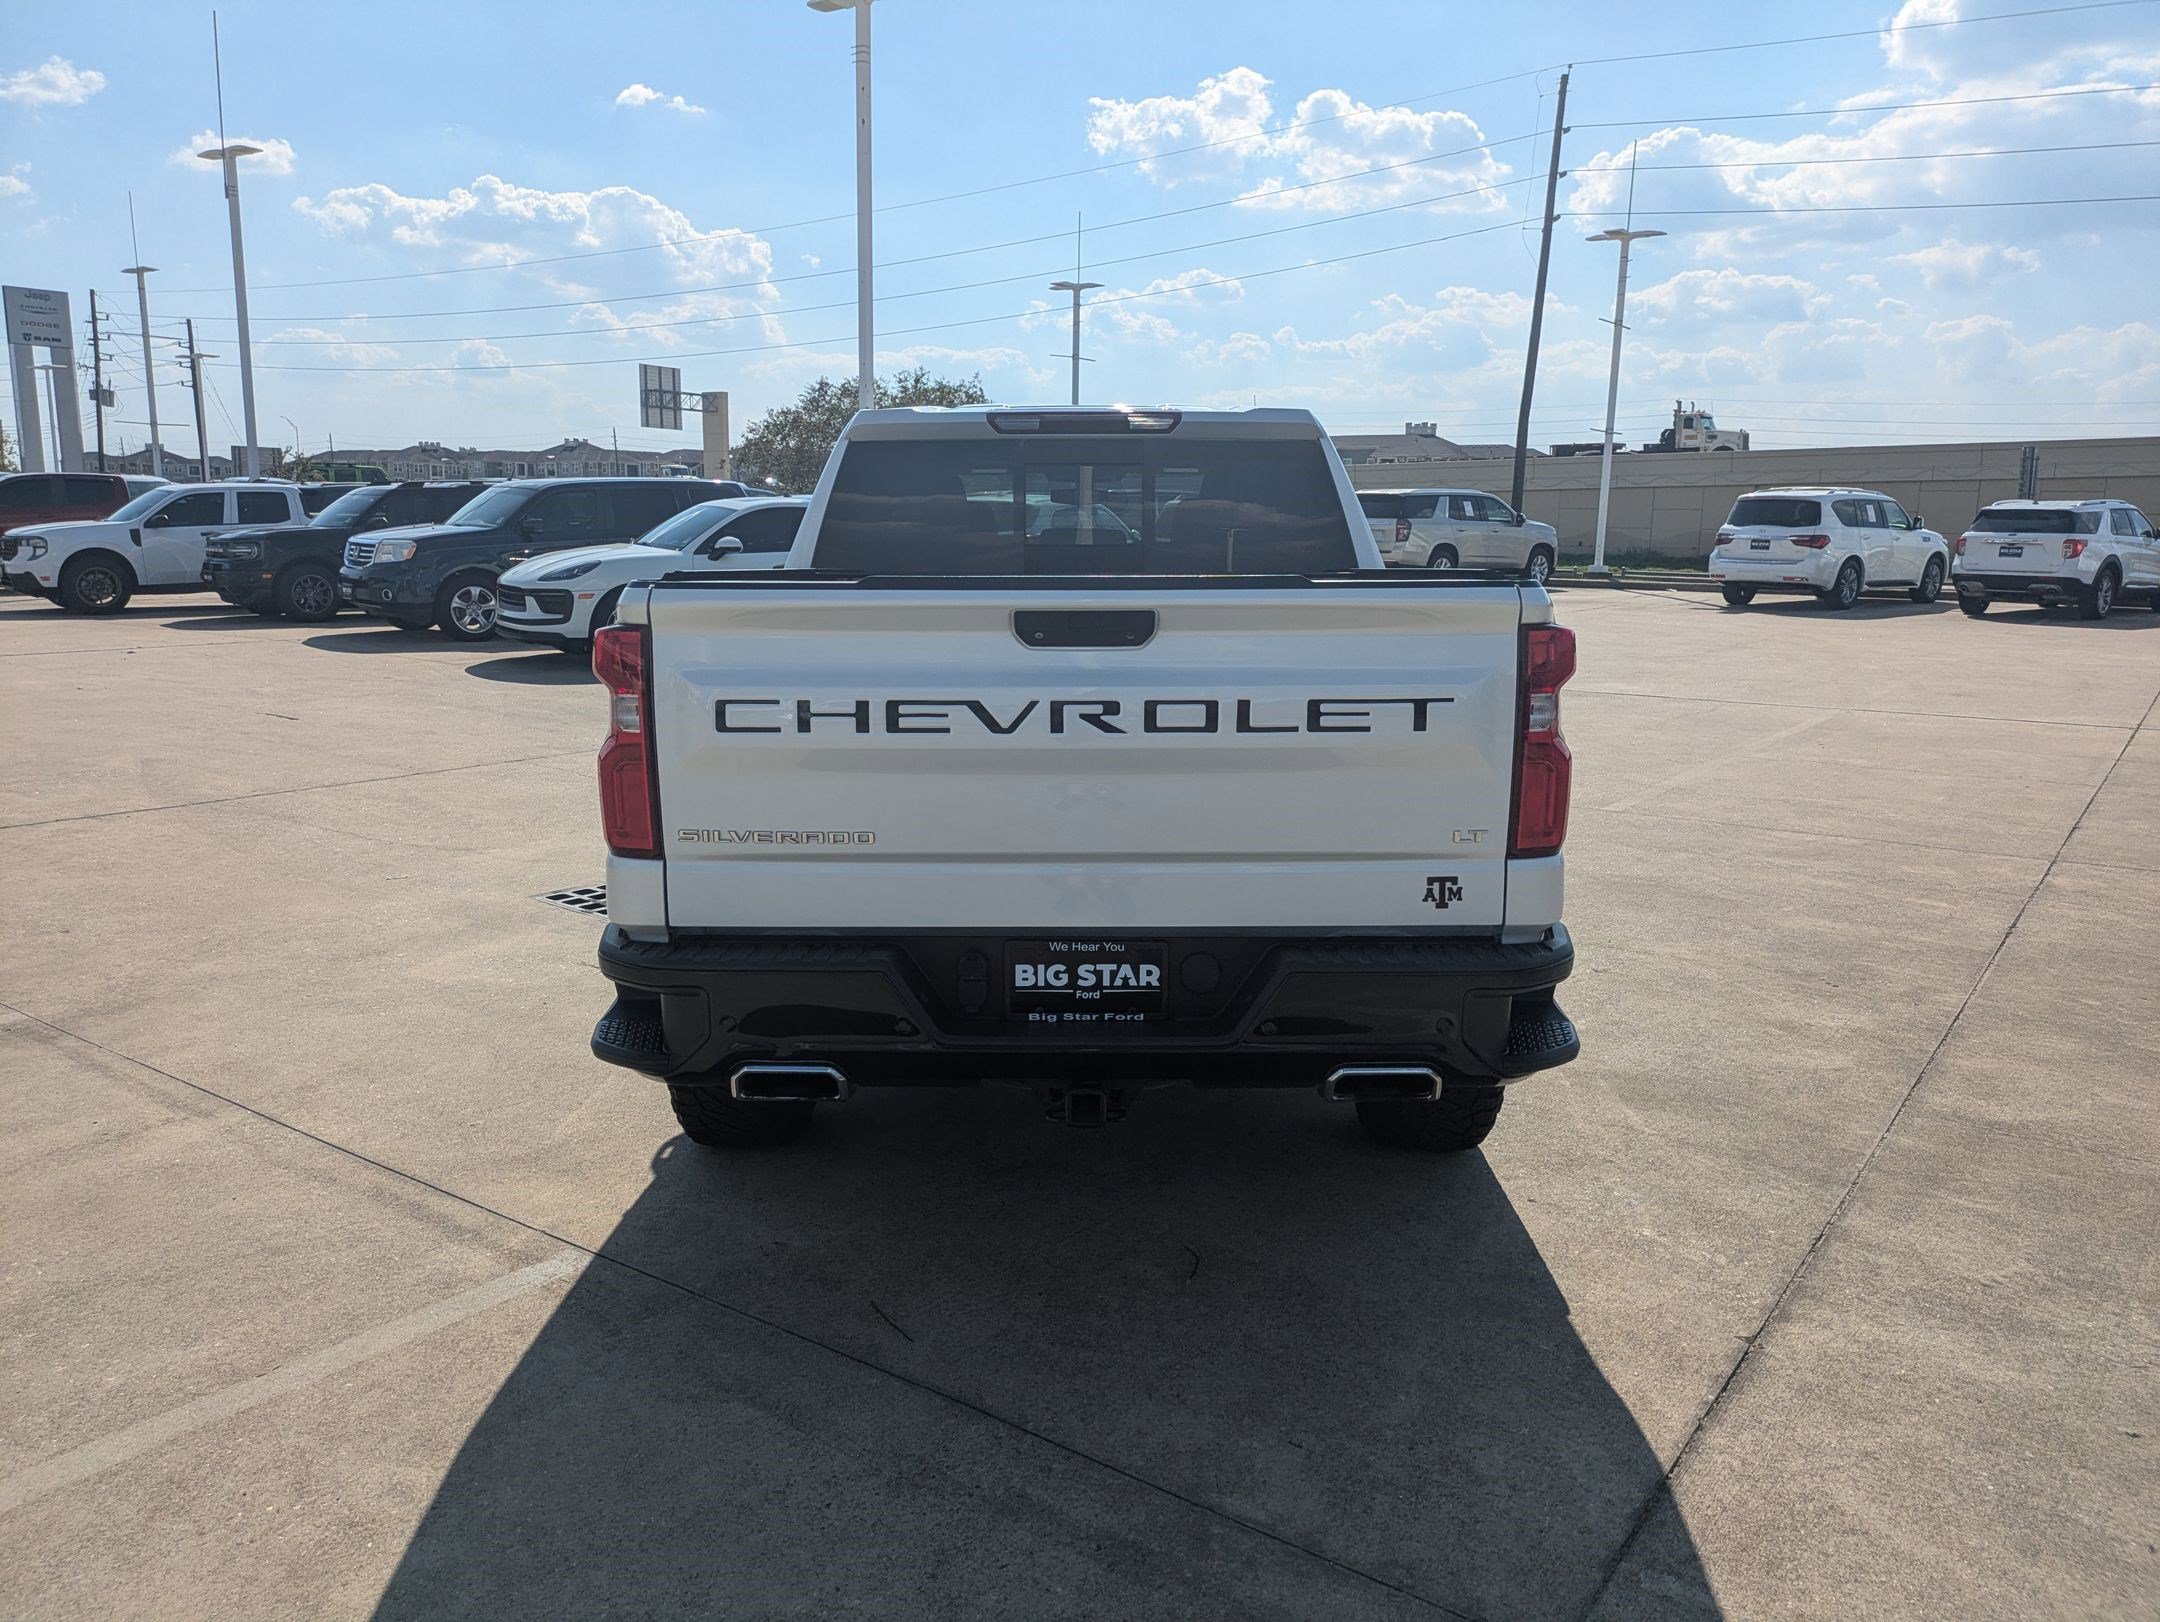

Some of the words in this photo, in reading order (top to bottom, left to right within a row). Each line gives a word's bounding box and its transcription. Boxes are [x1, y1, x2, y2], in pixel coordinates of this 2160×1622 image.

[20, 320, 60, 329] DODGE
[715, 697, 1455, 734] CHEVROLET
[677, 829, 876, 845] SILVERADO
[1452, 829, 1489, 844] LT
[1049, 942, 1069, 952] We
[1072, 942, 1100, 952] Hear
[1103, 942, 1125, 952] You
[1015, 963, 1069, 987] BIG
[1077, 963, 1161, 987] STAR
[1075, 990, 1100, 999] Ford
[1028, 1012, 1057, 1022] Big
[1063, 1012, 1099, 1021] Star
[1104, 1012, 1144, 1021] Ford
